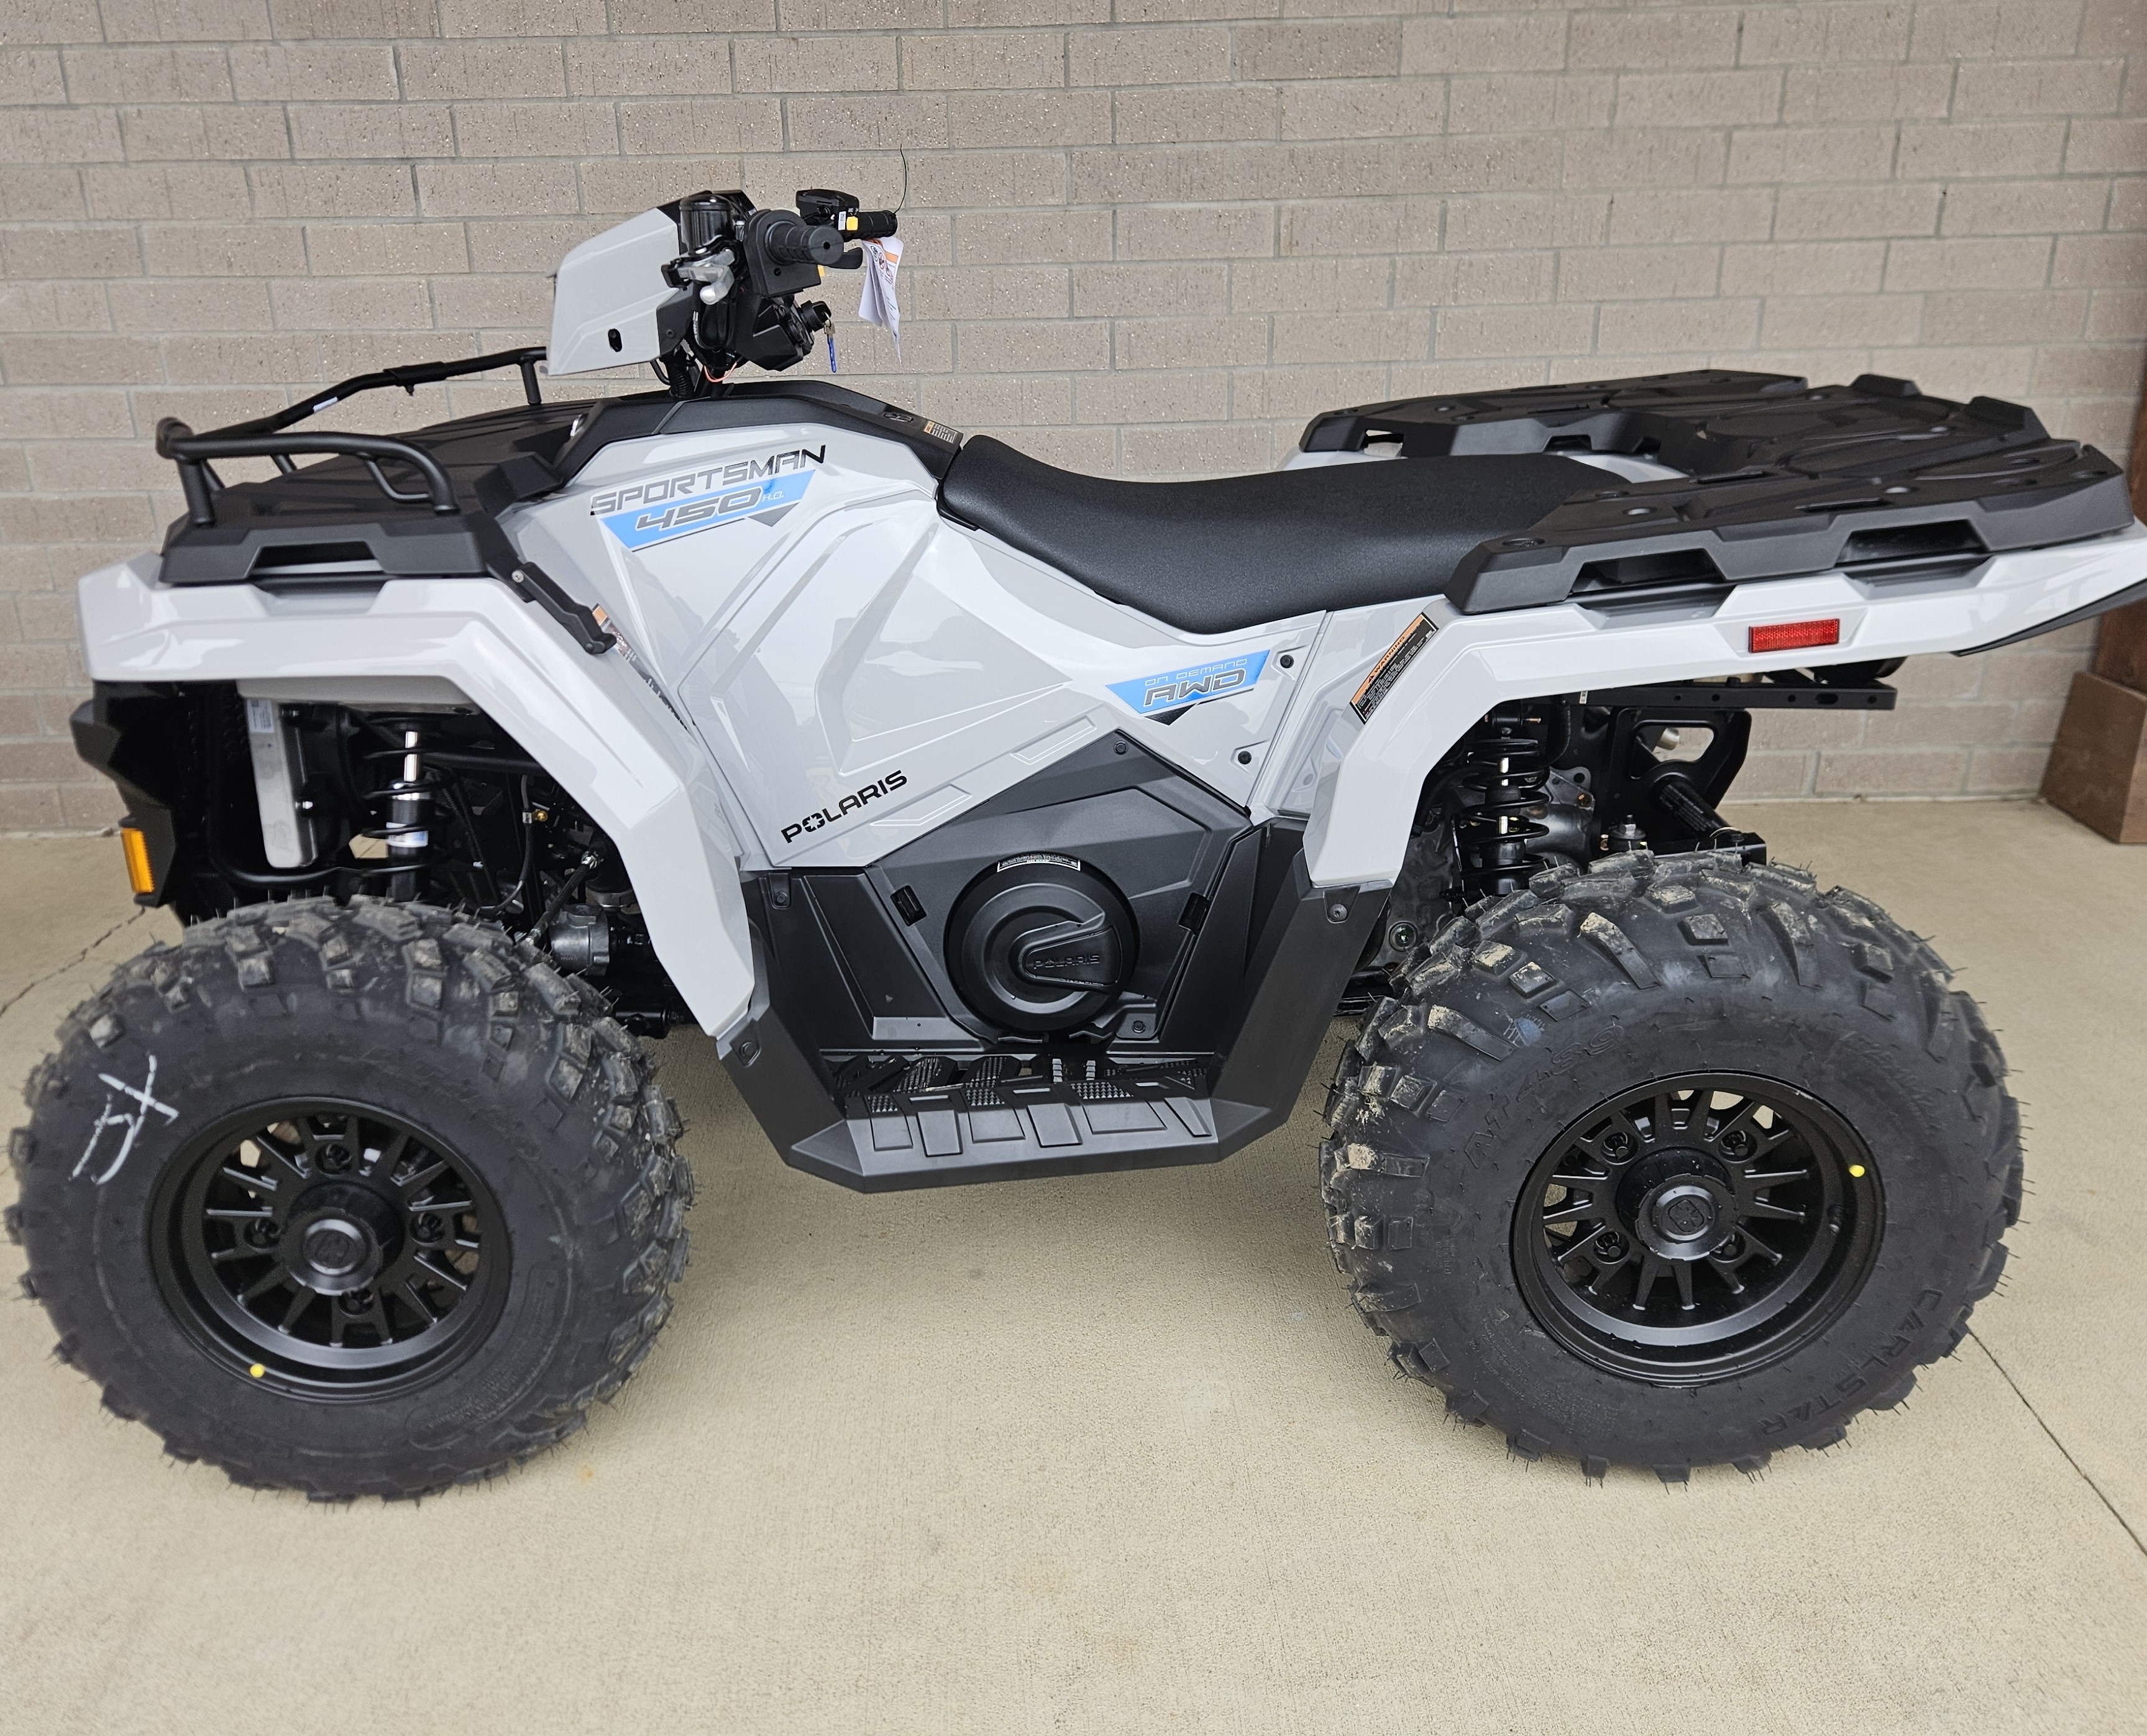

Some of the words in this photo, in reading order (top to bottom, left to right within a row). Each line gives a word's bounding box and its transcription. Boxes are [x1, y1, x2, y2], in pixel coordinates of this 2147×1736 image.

[590, 444, 826, 516] SPORTSMAN
[636, 487, 763, 531] 450
[1144, 675, 1168, 687] ON
[1176, 658, 1248, 680] DEMAND
[1373, 636, 1406, 674] WARNING
[1143, 668, 1247, 708] AWD
[781, 769, 908, 844] POLARIS
[1033, 954, 1100, 969] POLARIS
[1756, 1287, 1944, 1437] CARLSTAR
